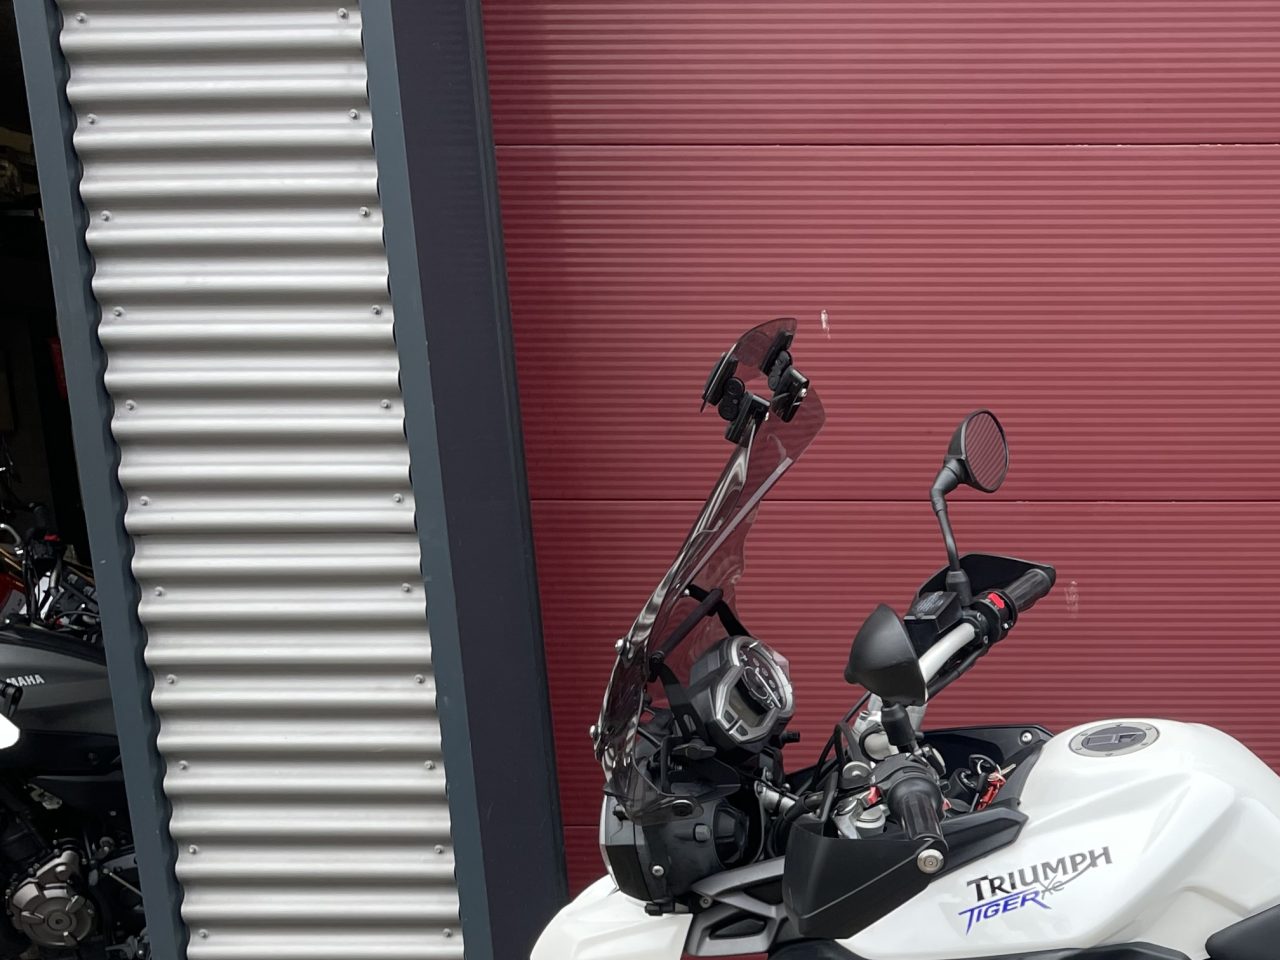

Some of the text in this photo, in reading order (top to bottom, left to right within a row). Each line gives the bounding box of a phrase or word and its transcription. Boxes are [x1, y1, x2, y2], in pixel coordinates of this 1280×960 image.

[6, 674, 45, 687] MAHA
[966, 846, 1113, 902] TRIUMPH
[958, 887, 1052, 936] TIGER
